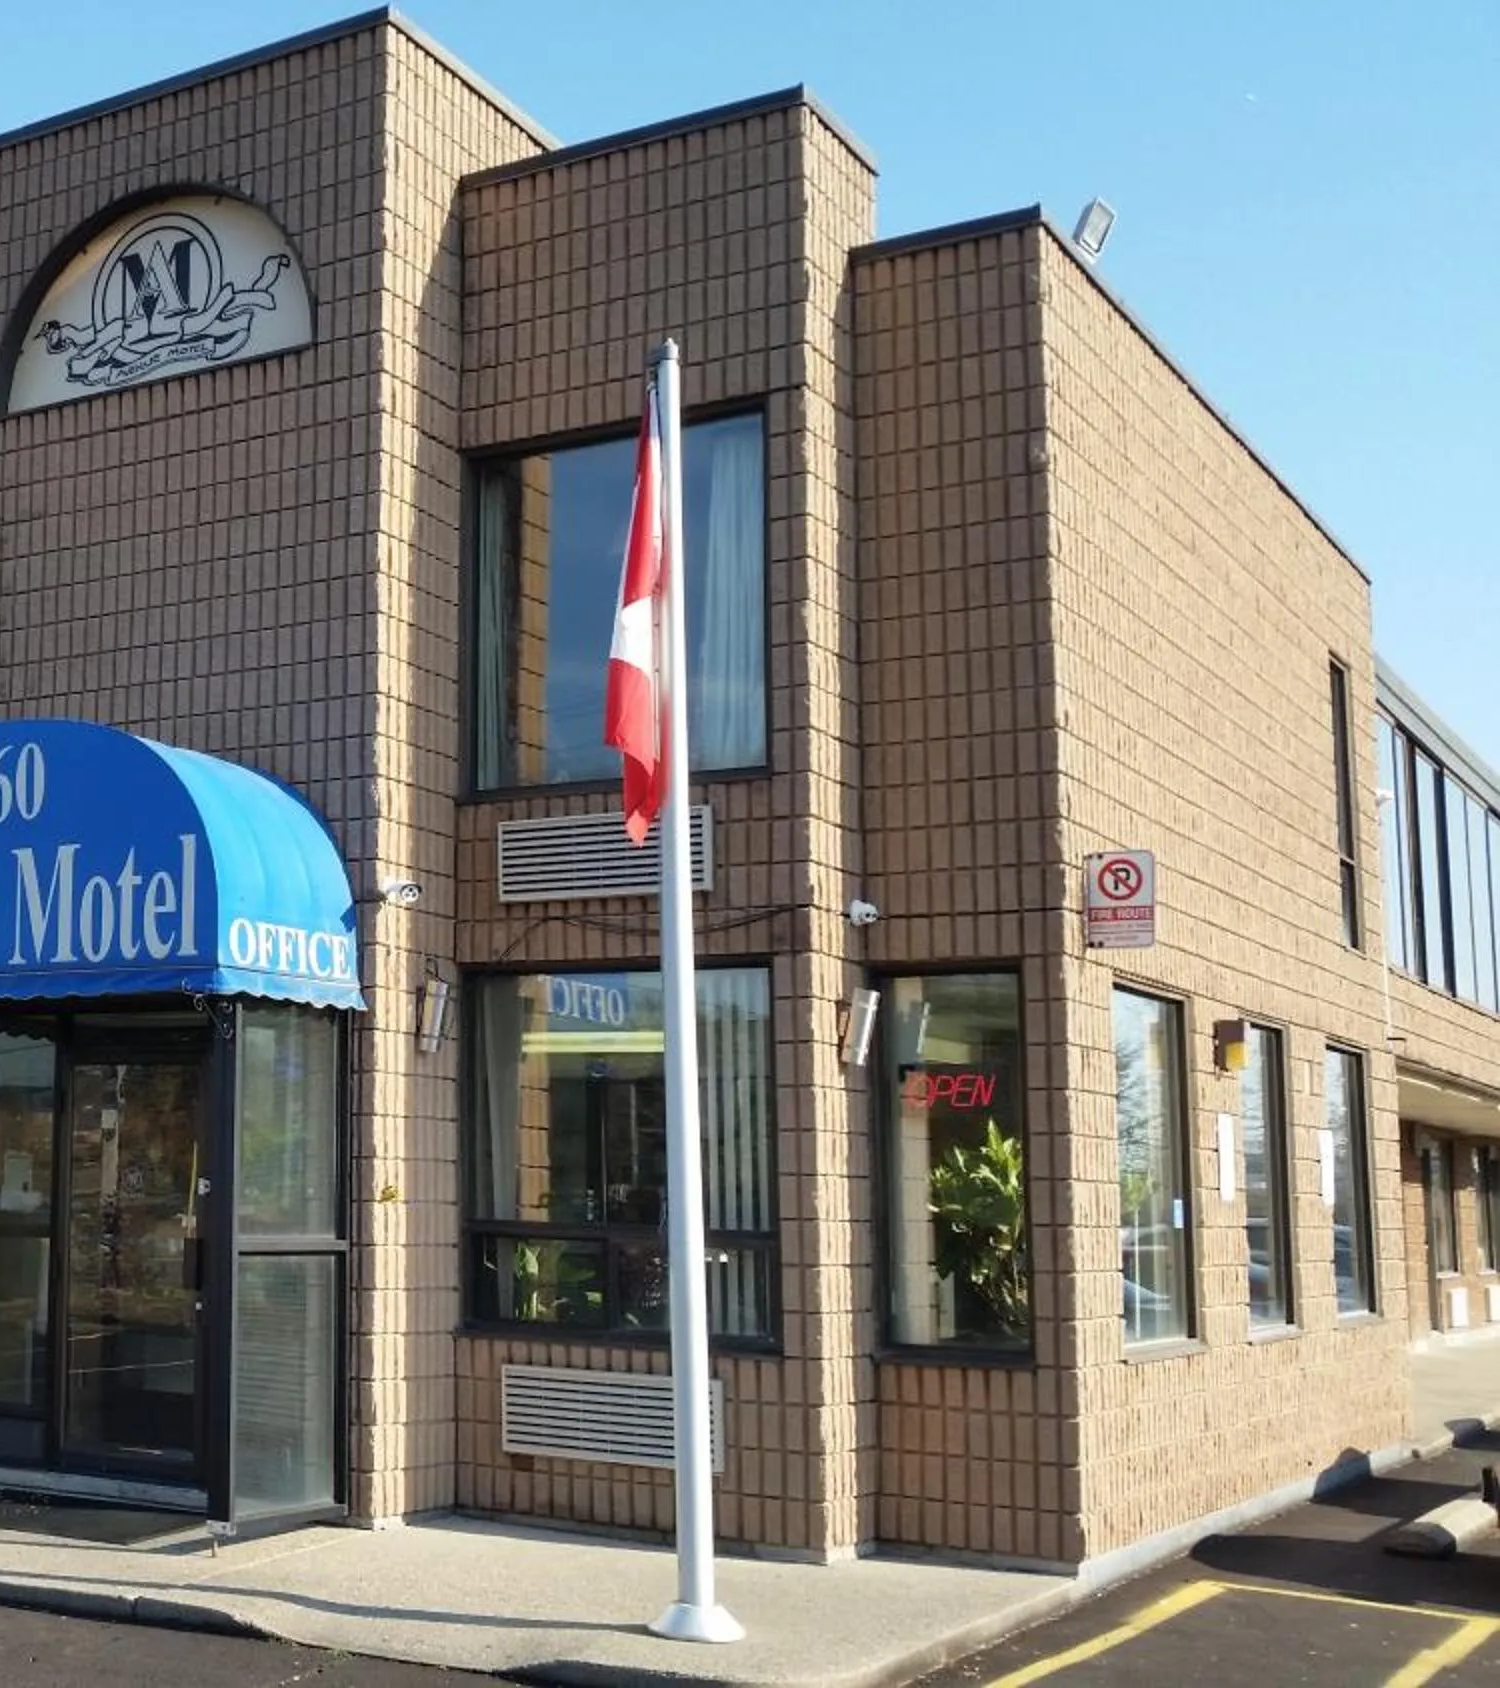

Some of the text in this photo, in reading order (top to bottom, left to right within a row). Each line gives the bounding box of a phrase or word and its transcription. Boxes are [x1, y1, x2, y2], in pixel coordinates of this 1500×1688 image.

[8, 833, 199, 965] Motel
[229, 917, 351, 979] OFFICE
[904, 1073, 997, 1107] OPEN
